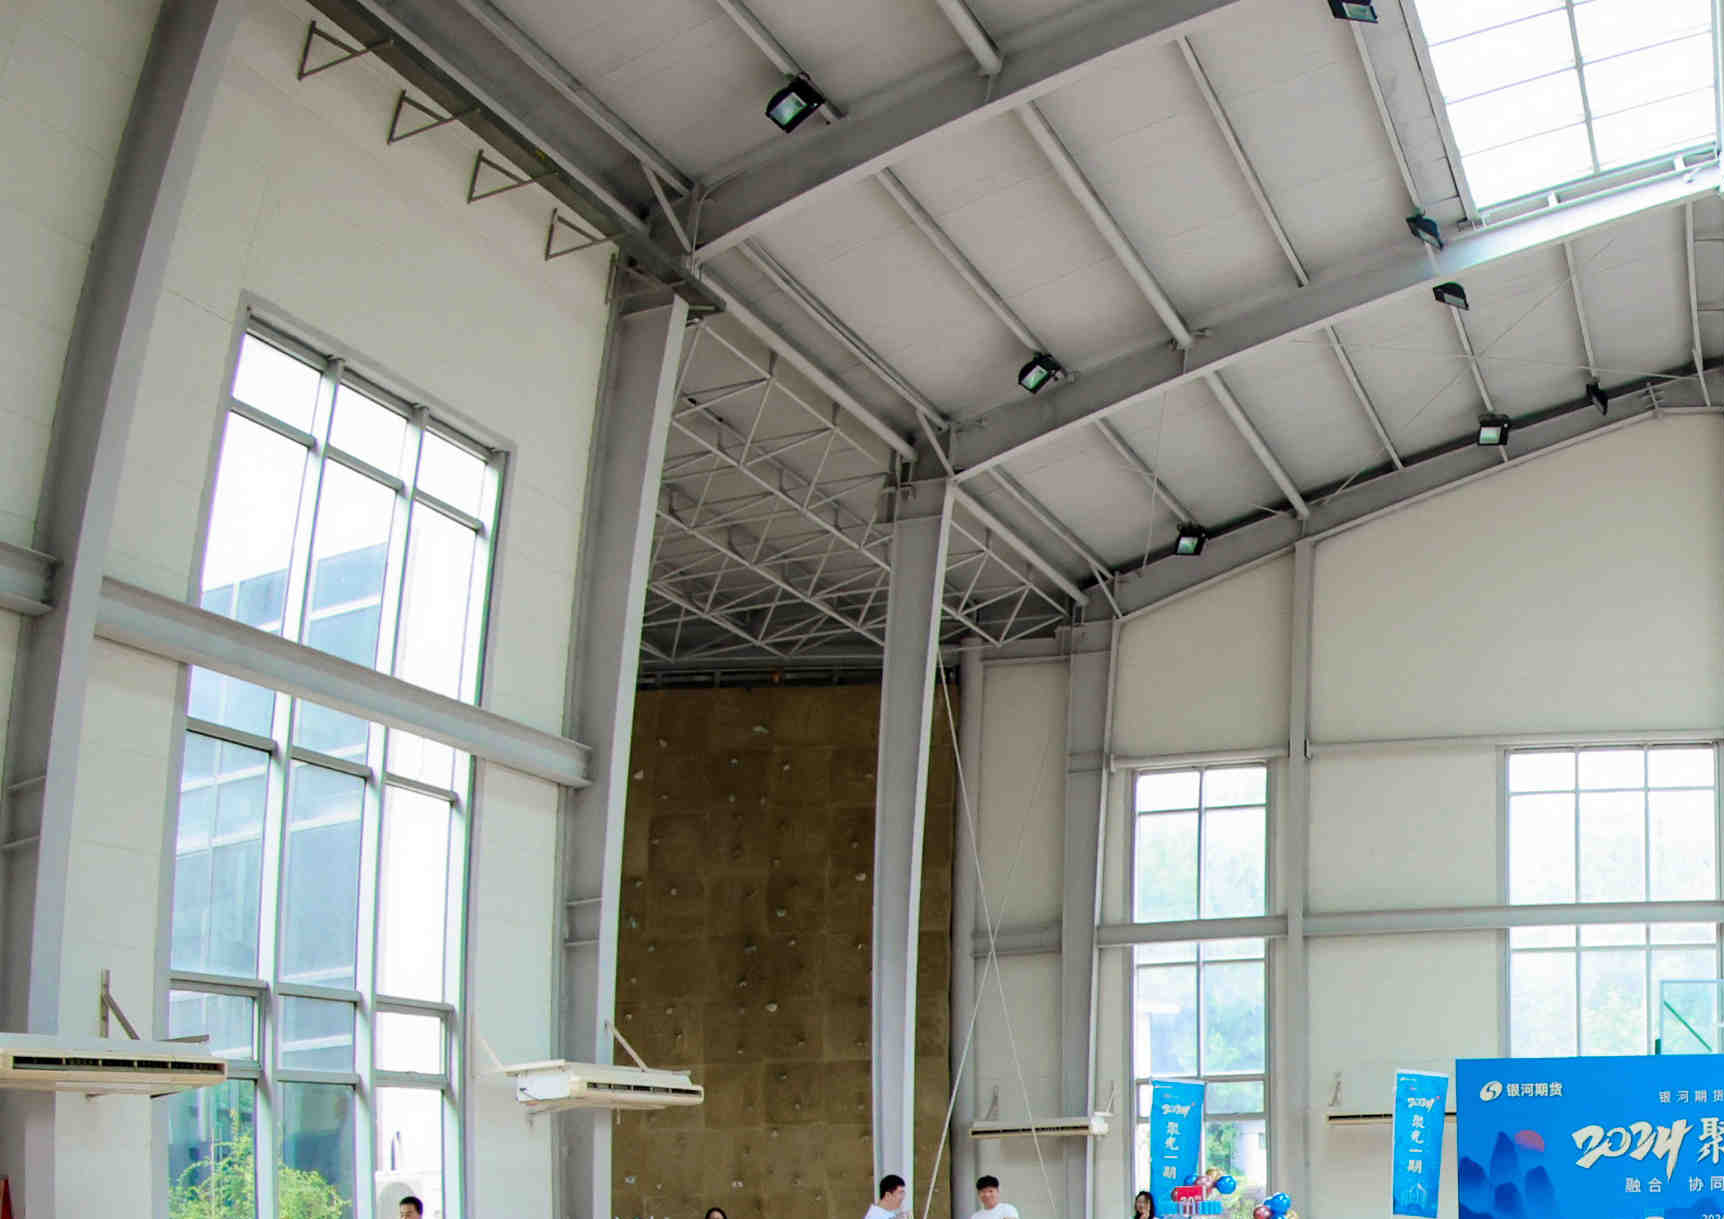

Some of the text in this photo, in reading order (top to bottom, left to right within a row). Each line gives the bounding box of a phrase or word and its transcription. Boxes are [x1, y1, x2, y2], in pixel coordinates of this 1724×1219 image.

[1507, 1082, 1563, 1097] 银河期货
[1571, 1119, 1693, 1182] 2024
[1625, 1177, 1662, 1193] 融合
